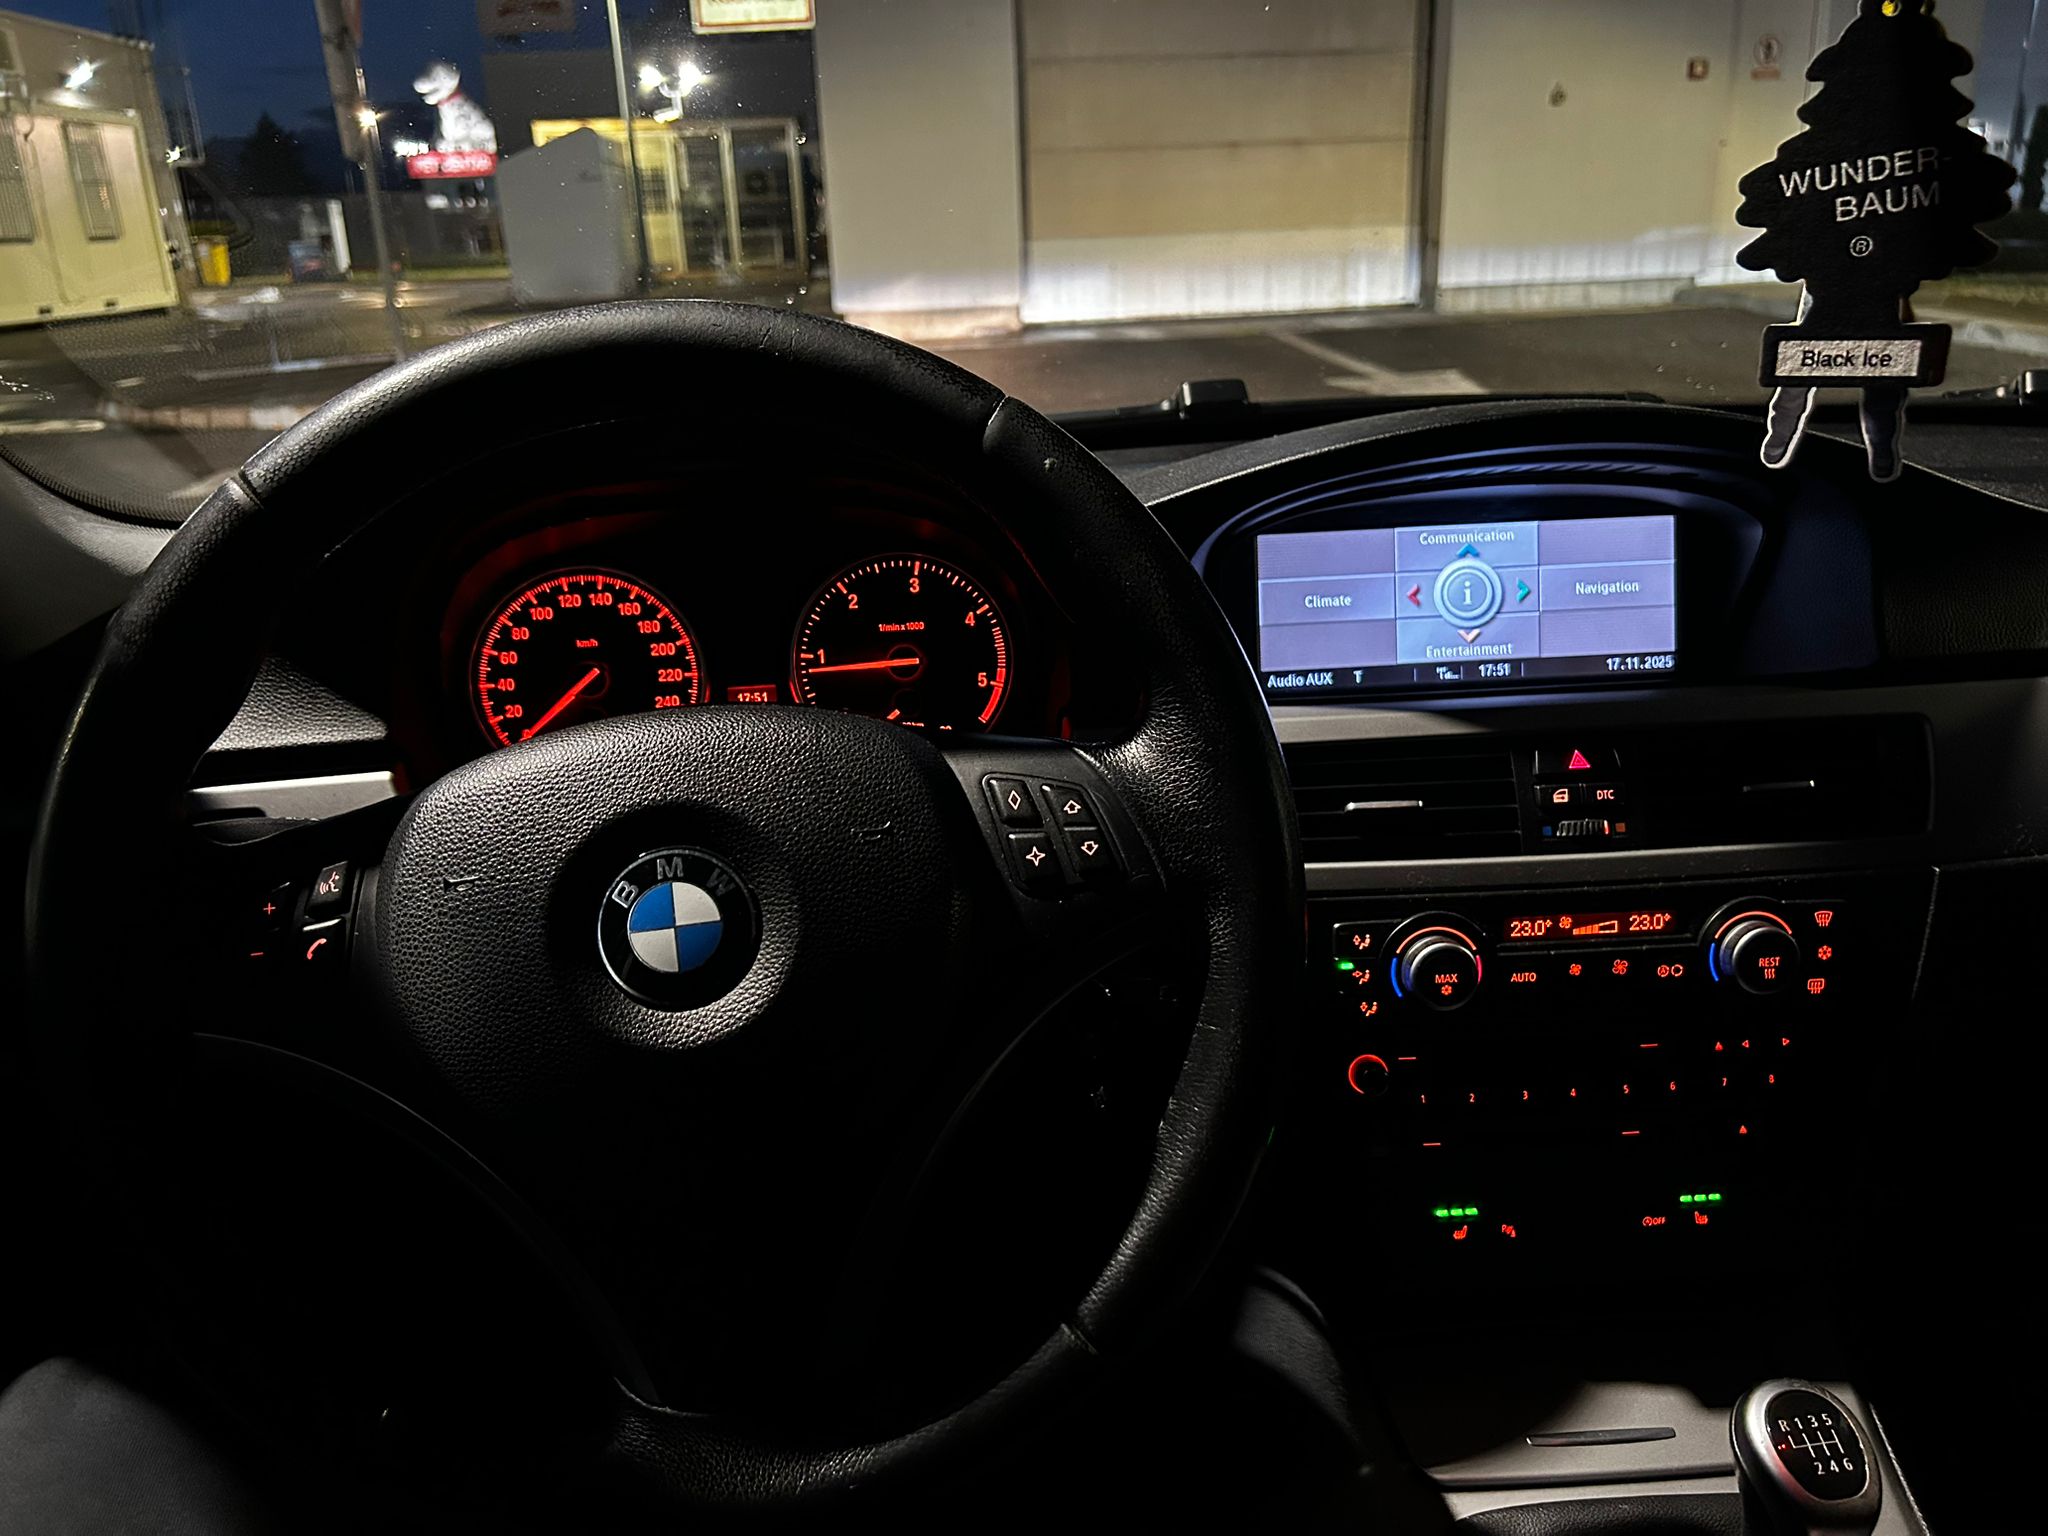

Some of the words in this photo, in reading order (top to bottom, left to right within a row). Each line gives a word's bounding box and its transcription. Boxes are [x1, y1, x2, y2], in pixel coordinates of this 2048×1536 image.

[1835, 181, 1940, 222] BAUM
[1801, 350, 1855, 368] Black
[1862, 350, 1893, 368] Ice
[1419, 529, 1515, 545] Communication
[909, 577, 920, 593] 3
[1575, 579, 1640, 597] Navigation
[557, 593, 582, 608] 120
[588, 592, 613, 607] 140
[847, 594, 859, 609] 2
[1304, 593, 1352, 609] Climate
[529, 606, 554, 621] 100
[617, 602, 641, 616] 160
[964, 611, 976, 627] 4
[511, 626, 530, 640] 80
[637, 620, 661, 634] 180
[650, 642, 676, 656] 200
[817, 648, 825, 664] 1
[1426, 643, 1513, 659] Entertainment
[499, 650, 518, 665] 60
[1606, 654, 1675, 672] 17.11.2025
[657, 668, 683, 682] 220
[1478, 662, 1512, 678] 17:51
[497, 678, 515, 692] 40
[977, 671, 988, 687] 5
[1267, 674, 1304, 688] Audio
[1305, 672, 1335, 686] AUX
[654, 695, 681, 708] 240
[737, 691, 768, 703] 17:51
[504, 704, 523, 718] 20
[1596, 789, 1615, 800] DTC
[611, 856, 736, 909] BMW
[1758, 956, 1781, 967] REST
[1434, 973, 1458, 984] MAX
[1510, 972, 1537, 983] AUTO
[1569, 1087, 1577, 1097] 4
[1623, 1084, 1630, 1094] 5
[1669, 1081, 1677, 1091] 6
[1469, 1092, 1475, 1103] 2
[1522, 1090, 1529, 1100] 3
[1778, 1419, 1791, 1432] R
[1794, 1417, 1803, 1430] 1
[1807, 1415, 1819, 1428] 3
[1821, 1413, 1833, 1426] 5
[1813, 1461, 1826, 1475] 2
[1830, 1459, 1840, 1473] 4
[1843, 1457, 1854, 1471] 6
